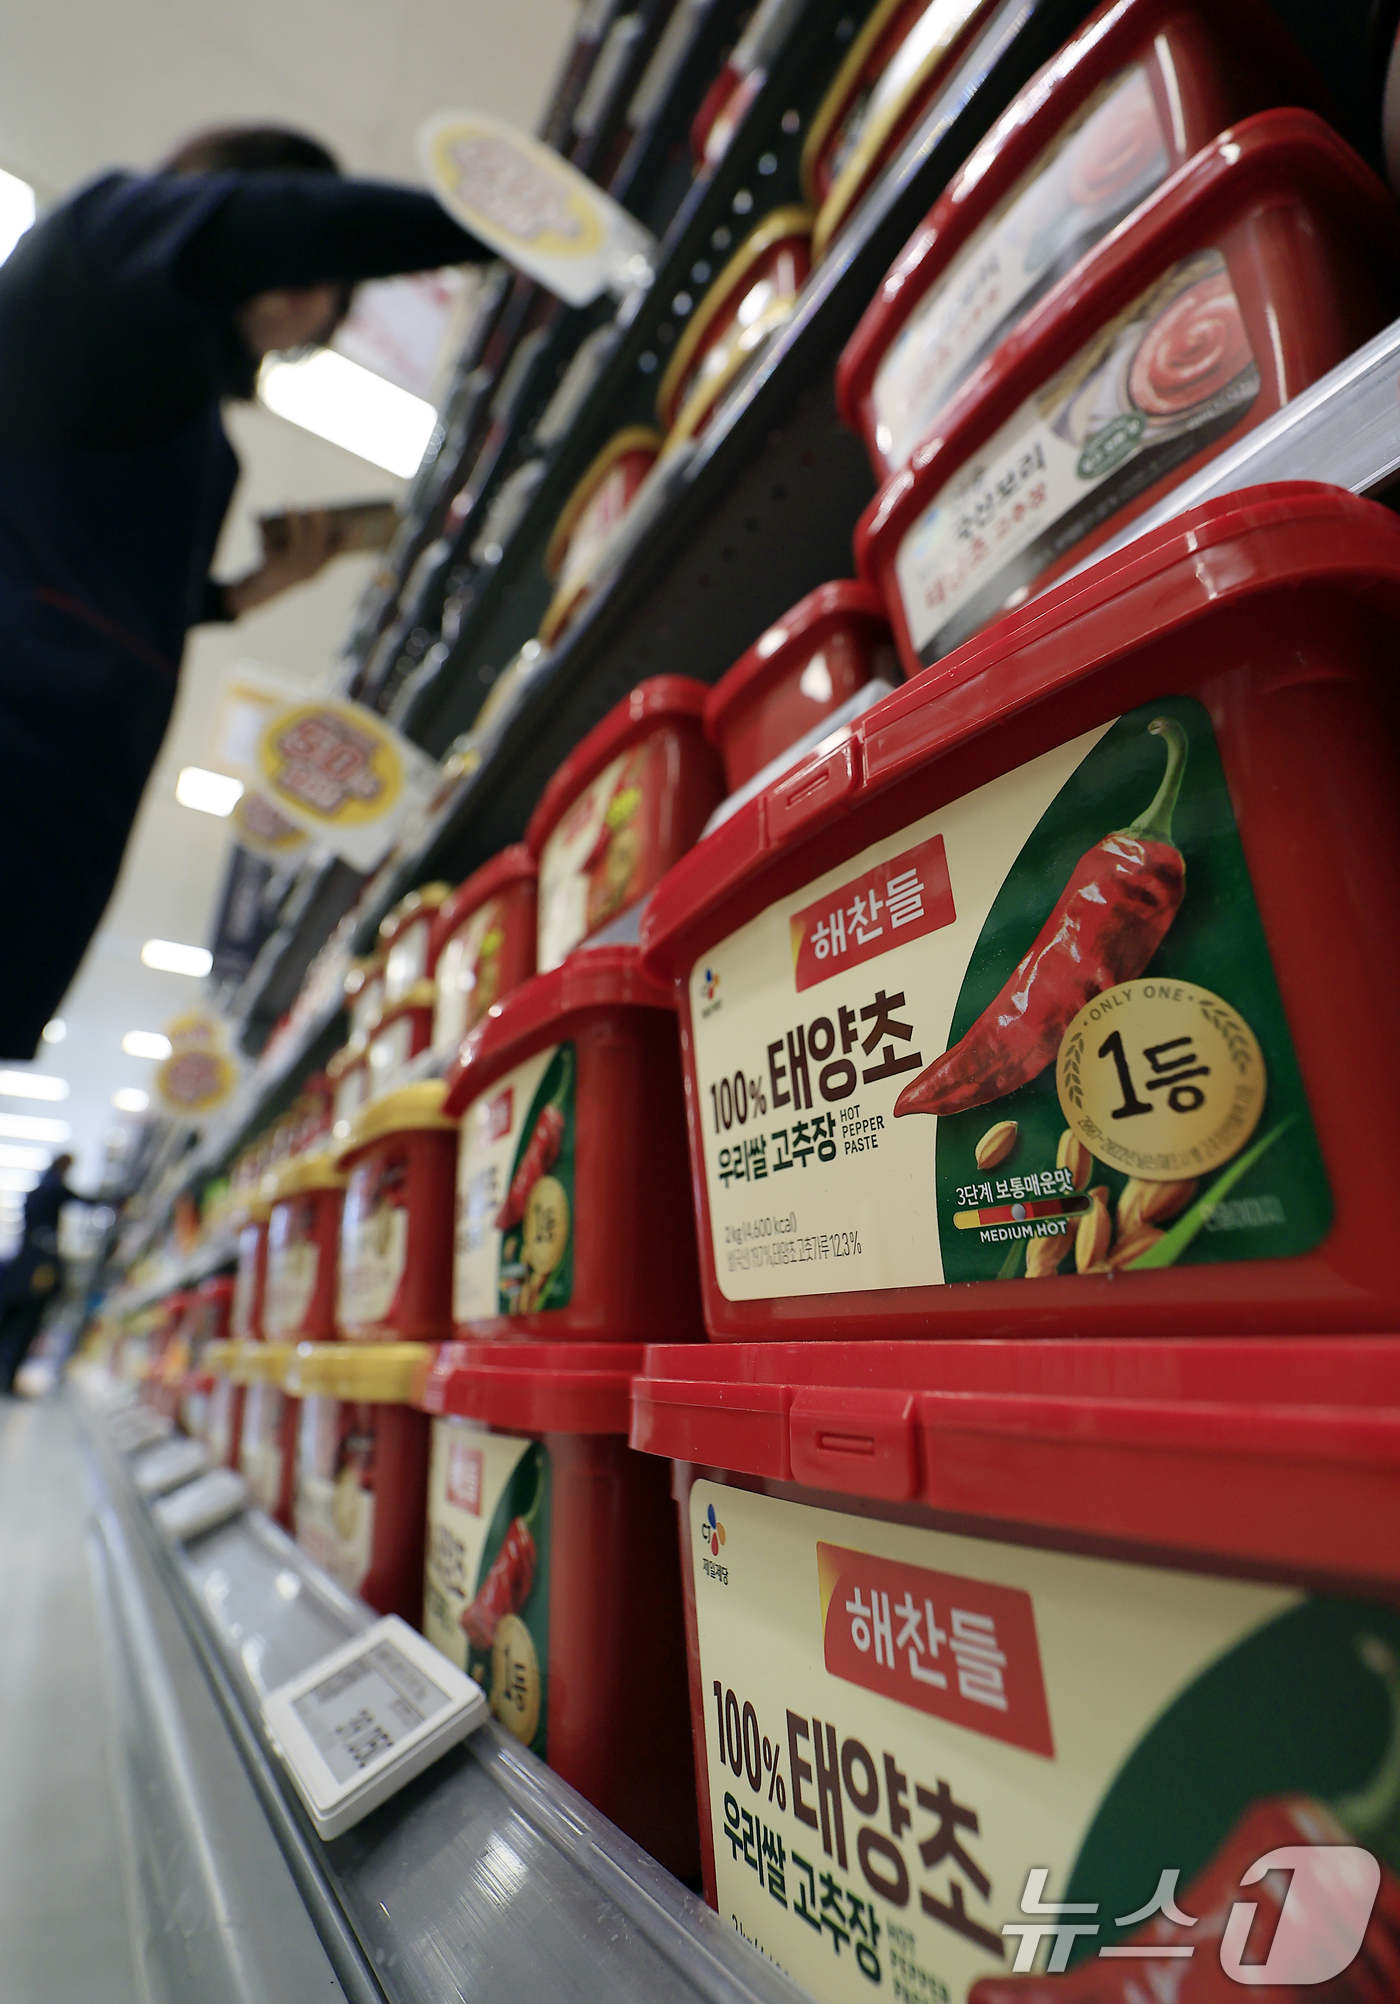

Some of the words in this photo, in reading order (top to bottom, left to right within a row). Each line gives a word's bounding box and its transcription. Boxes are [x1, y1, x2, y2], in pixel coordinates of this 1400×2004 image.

[810, 868, 925, 960] 해찬들
[1089, 988, 1132, 1021] ONLY
[1143, 985, 1185, 1001] ONE
[710, 1070, 767, 1134] 100%
[767, 989, 923, 1111] 태양초
[1098, 1030, 1210, 1119] 1등
[840, 1105, 861, 1122] HOT
[842, 1115, 885, 1138] PEPPER
[719, 1134, 768, 1189] 우리쌀
[771, 1112, 837, 1171] 고추장
[844, 1134, 879, 1155] PASTE
[955, 1182, 994, 1206] 3단계
[829, 1230, 862, 1258] 12.3%
[979, 1224, 1034, 1243] MEDIUM
[1037, 1220, 1067, 1238] HOT
[701, 1522, 711, 1544] CJ
[702, 1557, 729, 1586] 제일제당
[844, 1586, 1008, 1713] 해찬들
[713, 1679, 787, 1812] 100%
[786, 1708, 1006, 1962] 태양초
[724, 1791, 788, 1910] 우리쌀
[790, 1849, 882, 1986] 고추장
